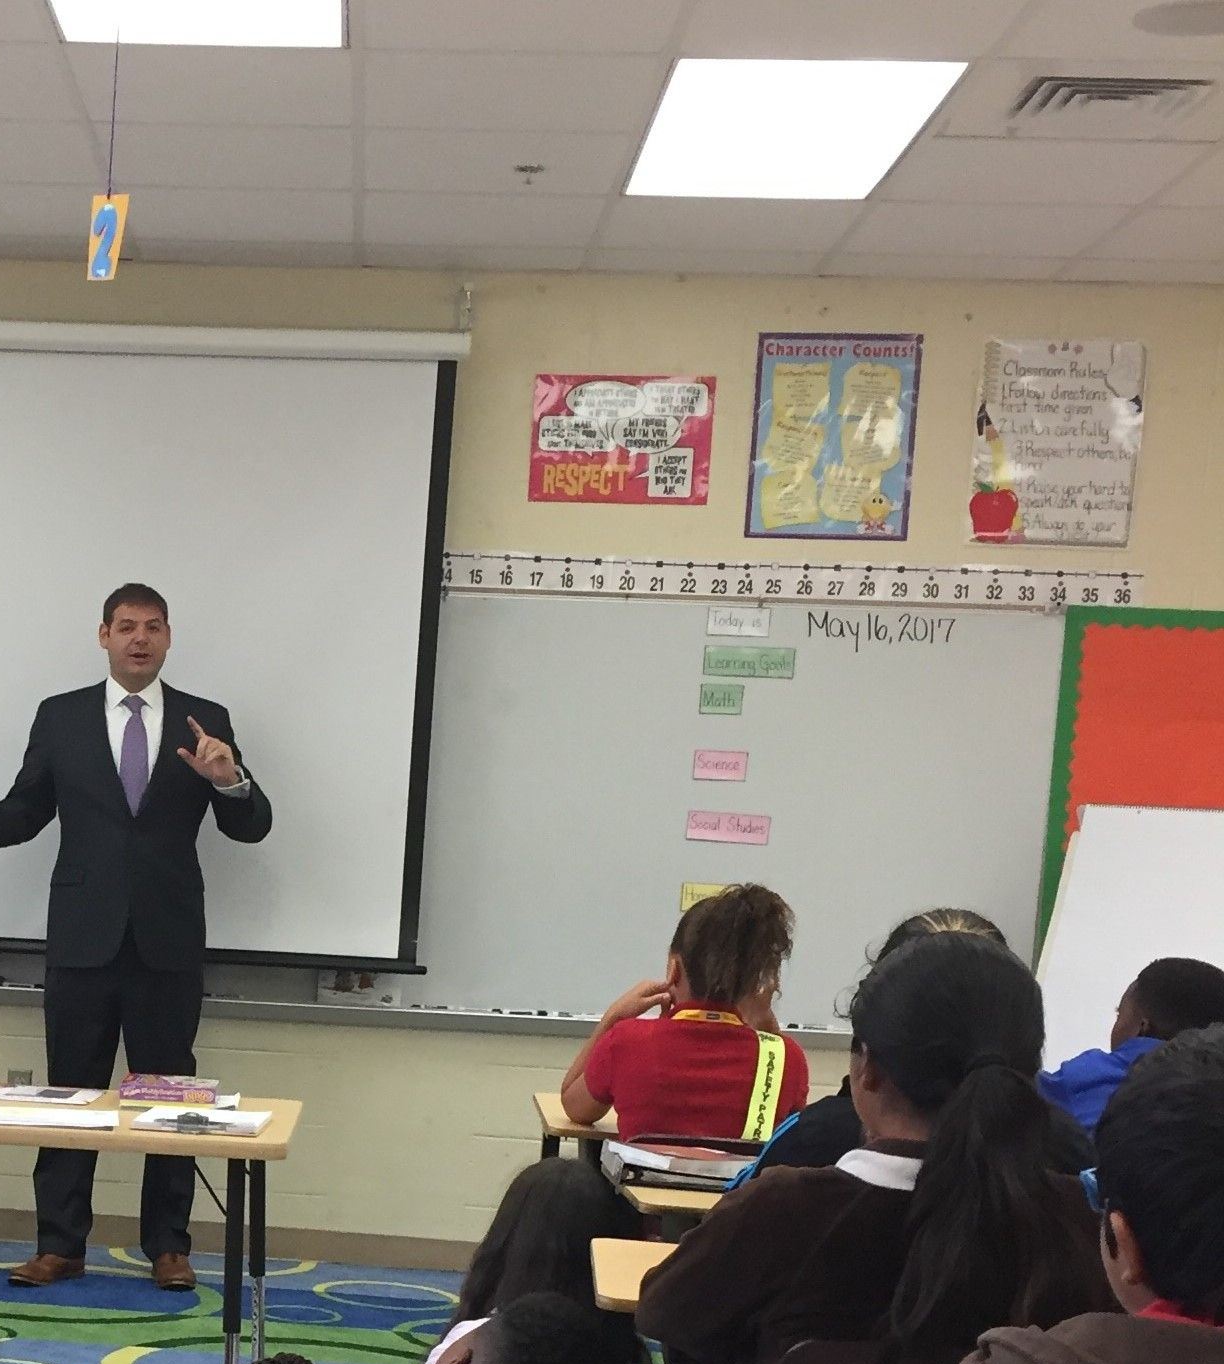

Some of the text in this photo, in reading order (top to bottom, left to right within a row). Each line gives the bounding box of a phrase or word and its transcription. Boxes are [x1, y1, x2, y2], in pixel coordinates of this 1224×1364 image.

[91, 204, 117, 278] 2
[765, 342, 916, 359] Character Counts!
[1003, 360, 1066, 377] Classroom
[1051, 383, 1107, 400] directions
[543, 463, 628, 496] RESPECT
[469, 569, 482, 584] 15
[499, 571, 513, 585] 16
[529, 572, 543, 586] 17
[560, 573, 574, 588] 18
[590, 574, 604, 589] 19
[619, 575, 635, 590] 20
[650, 577, 664, 591] 21
[680, 578, 696, 593] 22
[711, 579, 727, 594] 23
[737, 579, 754, 594] 24
[765, 579, 781, 594] 25
[796, 580, 813, 596] 26
[827, 581, 844, 596] 27
[859, 581, 875, 596] 28
[891, 582, 908, 597] 29
[922, 583, 939, 599] 30
[954, 583, 969, 599] 31
[986, 584, 1003, 600] 32
[1018, 585, 1035, 601] 33
[1049, 586, 1067, 602] 34
[1081, 587, 1099, 603] 35
[1114, 588, 1131, 604] 36
[713, 610, 762, 631] Today is
[808, 611, 860, 652] May
[898, 613, 956, 644] 2017
[708, 654, 790, 676] Learning Goals
[703, 690, 735, 707] Math
[697, 753, 740, 770] Science
[690, 814, 766, 834] Social Studies
